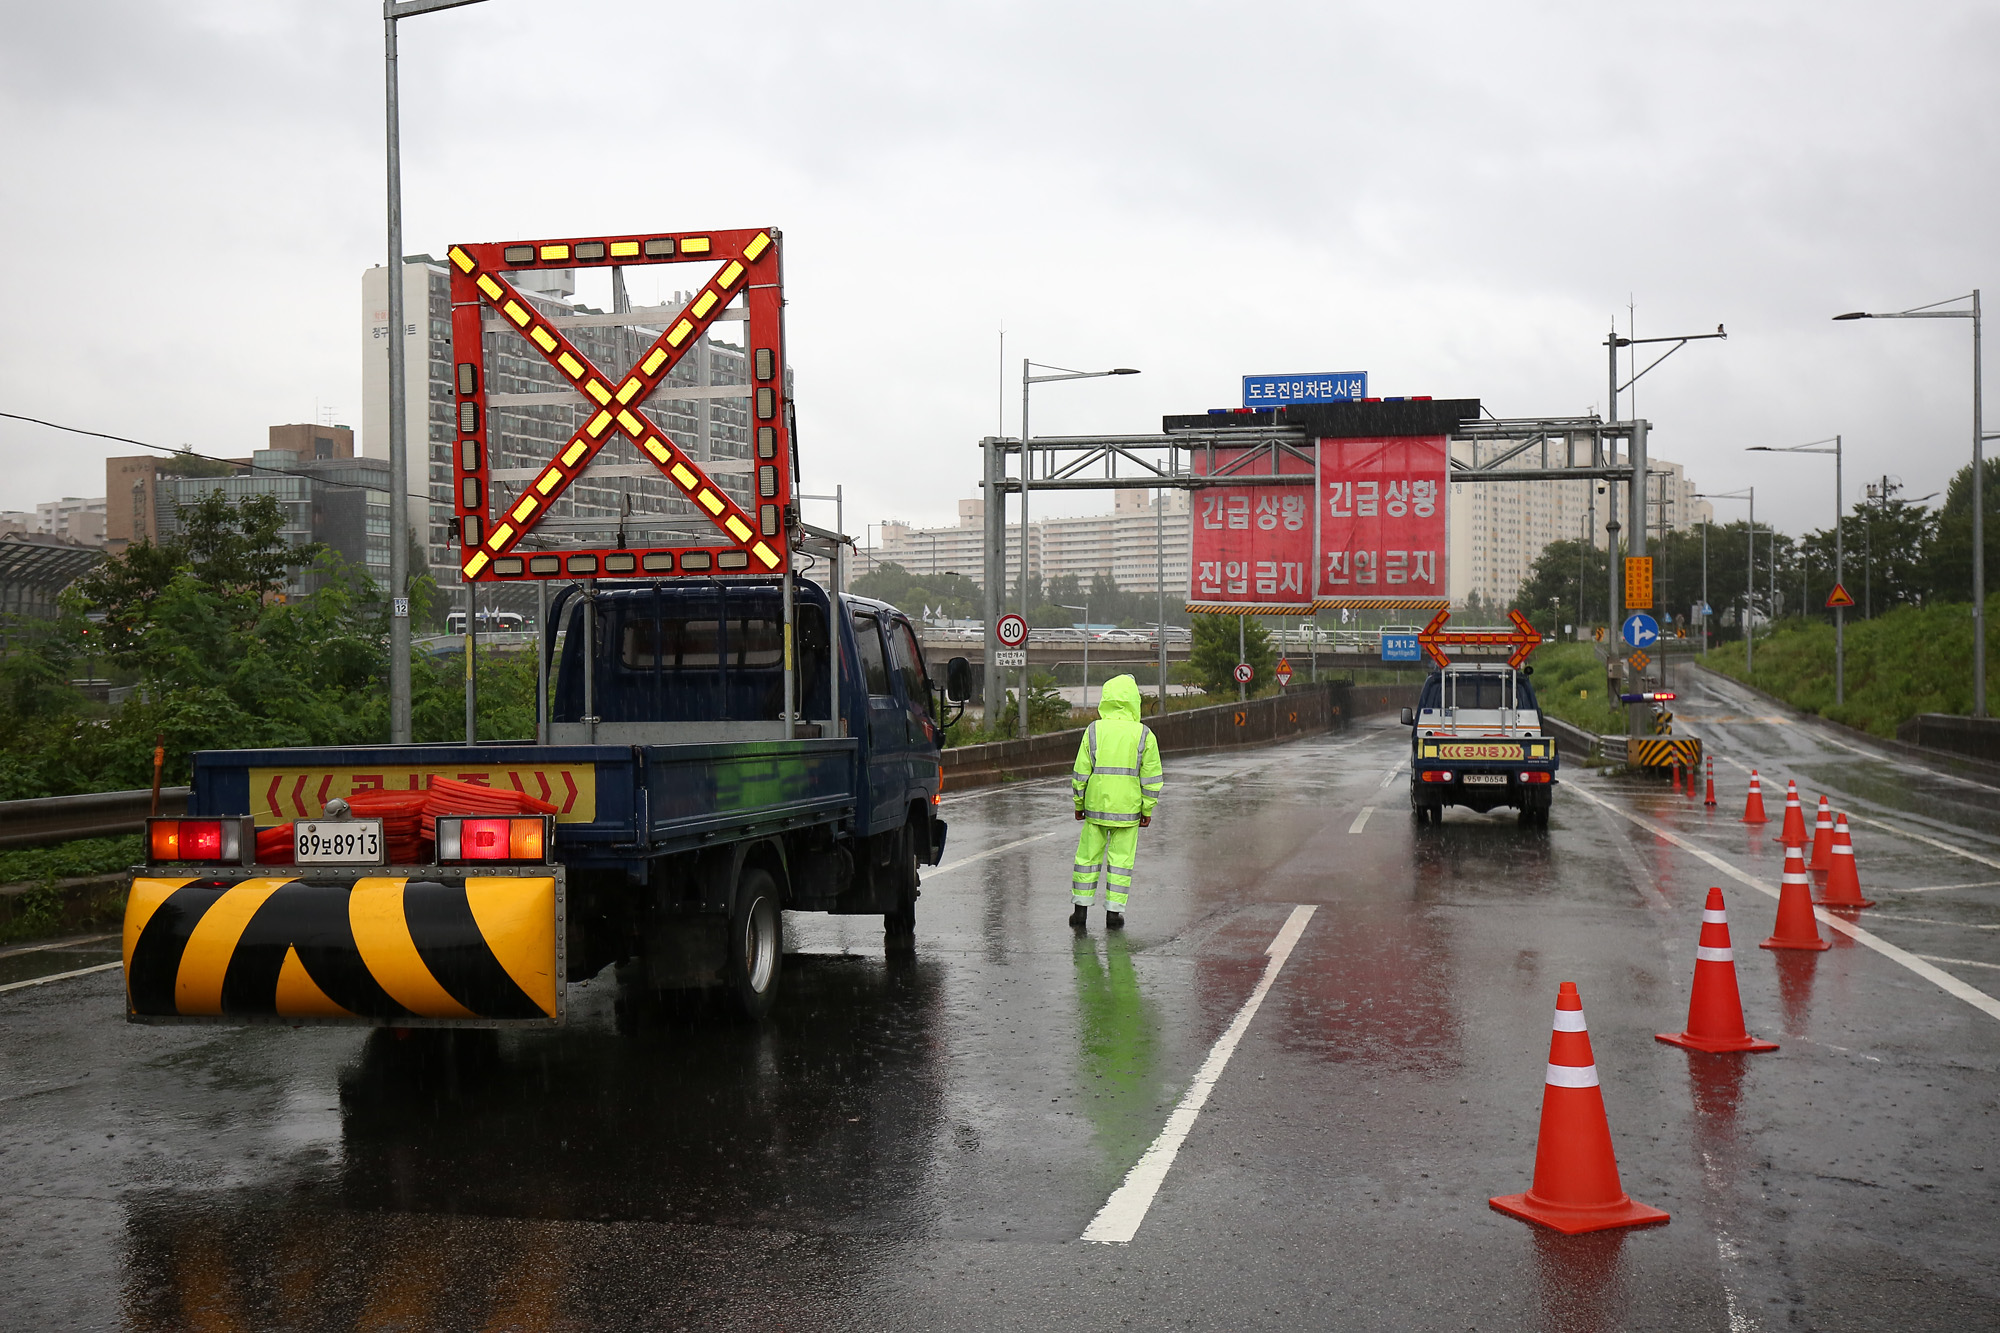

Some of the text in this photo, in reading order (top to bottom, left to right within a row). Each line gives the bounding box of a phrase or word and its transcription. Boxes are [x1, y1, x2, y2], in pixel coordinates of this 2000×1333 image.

[1249, 380, 1362, 399] 도로진입차단시설
[396, 604, 407, 613] 12
[1004, 623, 1020, 638] 80
[1463, 746, 1499, 758] 공사중
[299, 834, 378, 856] 89보8913
